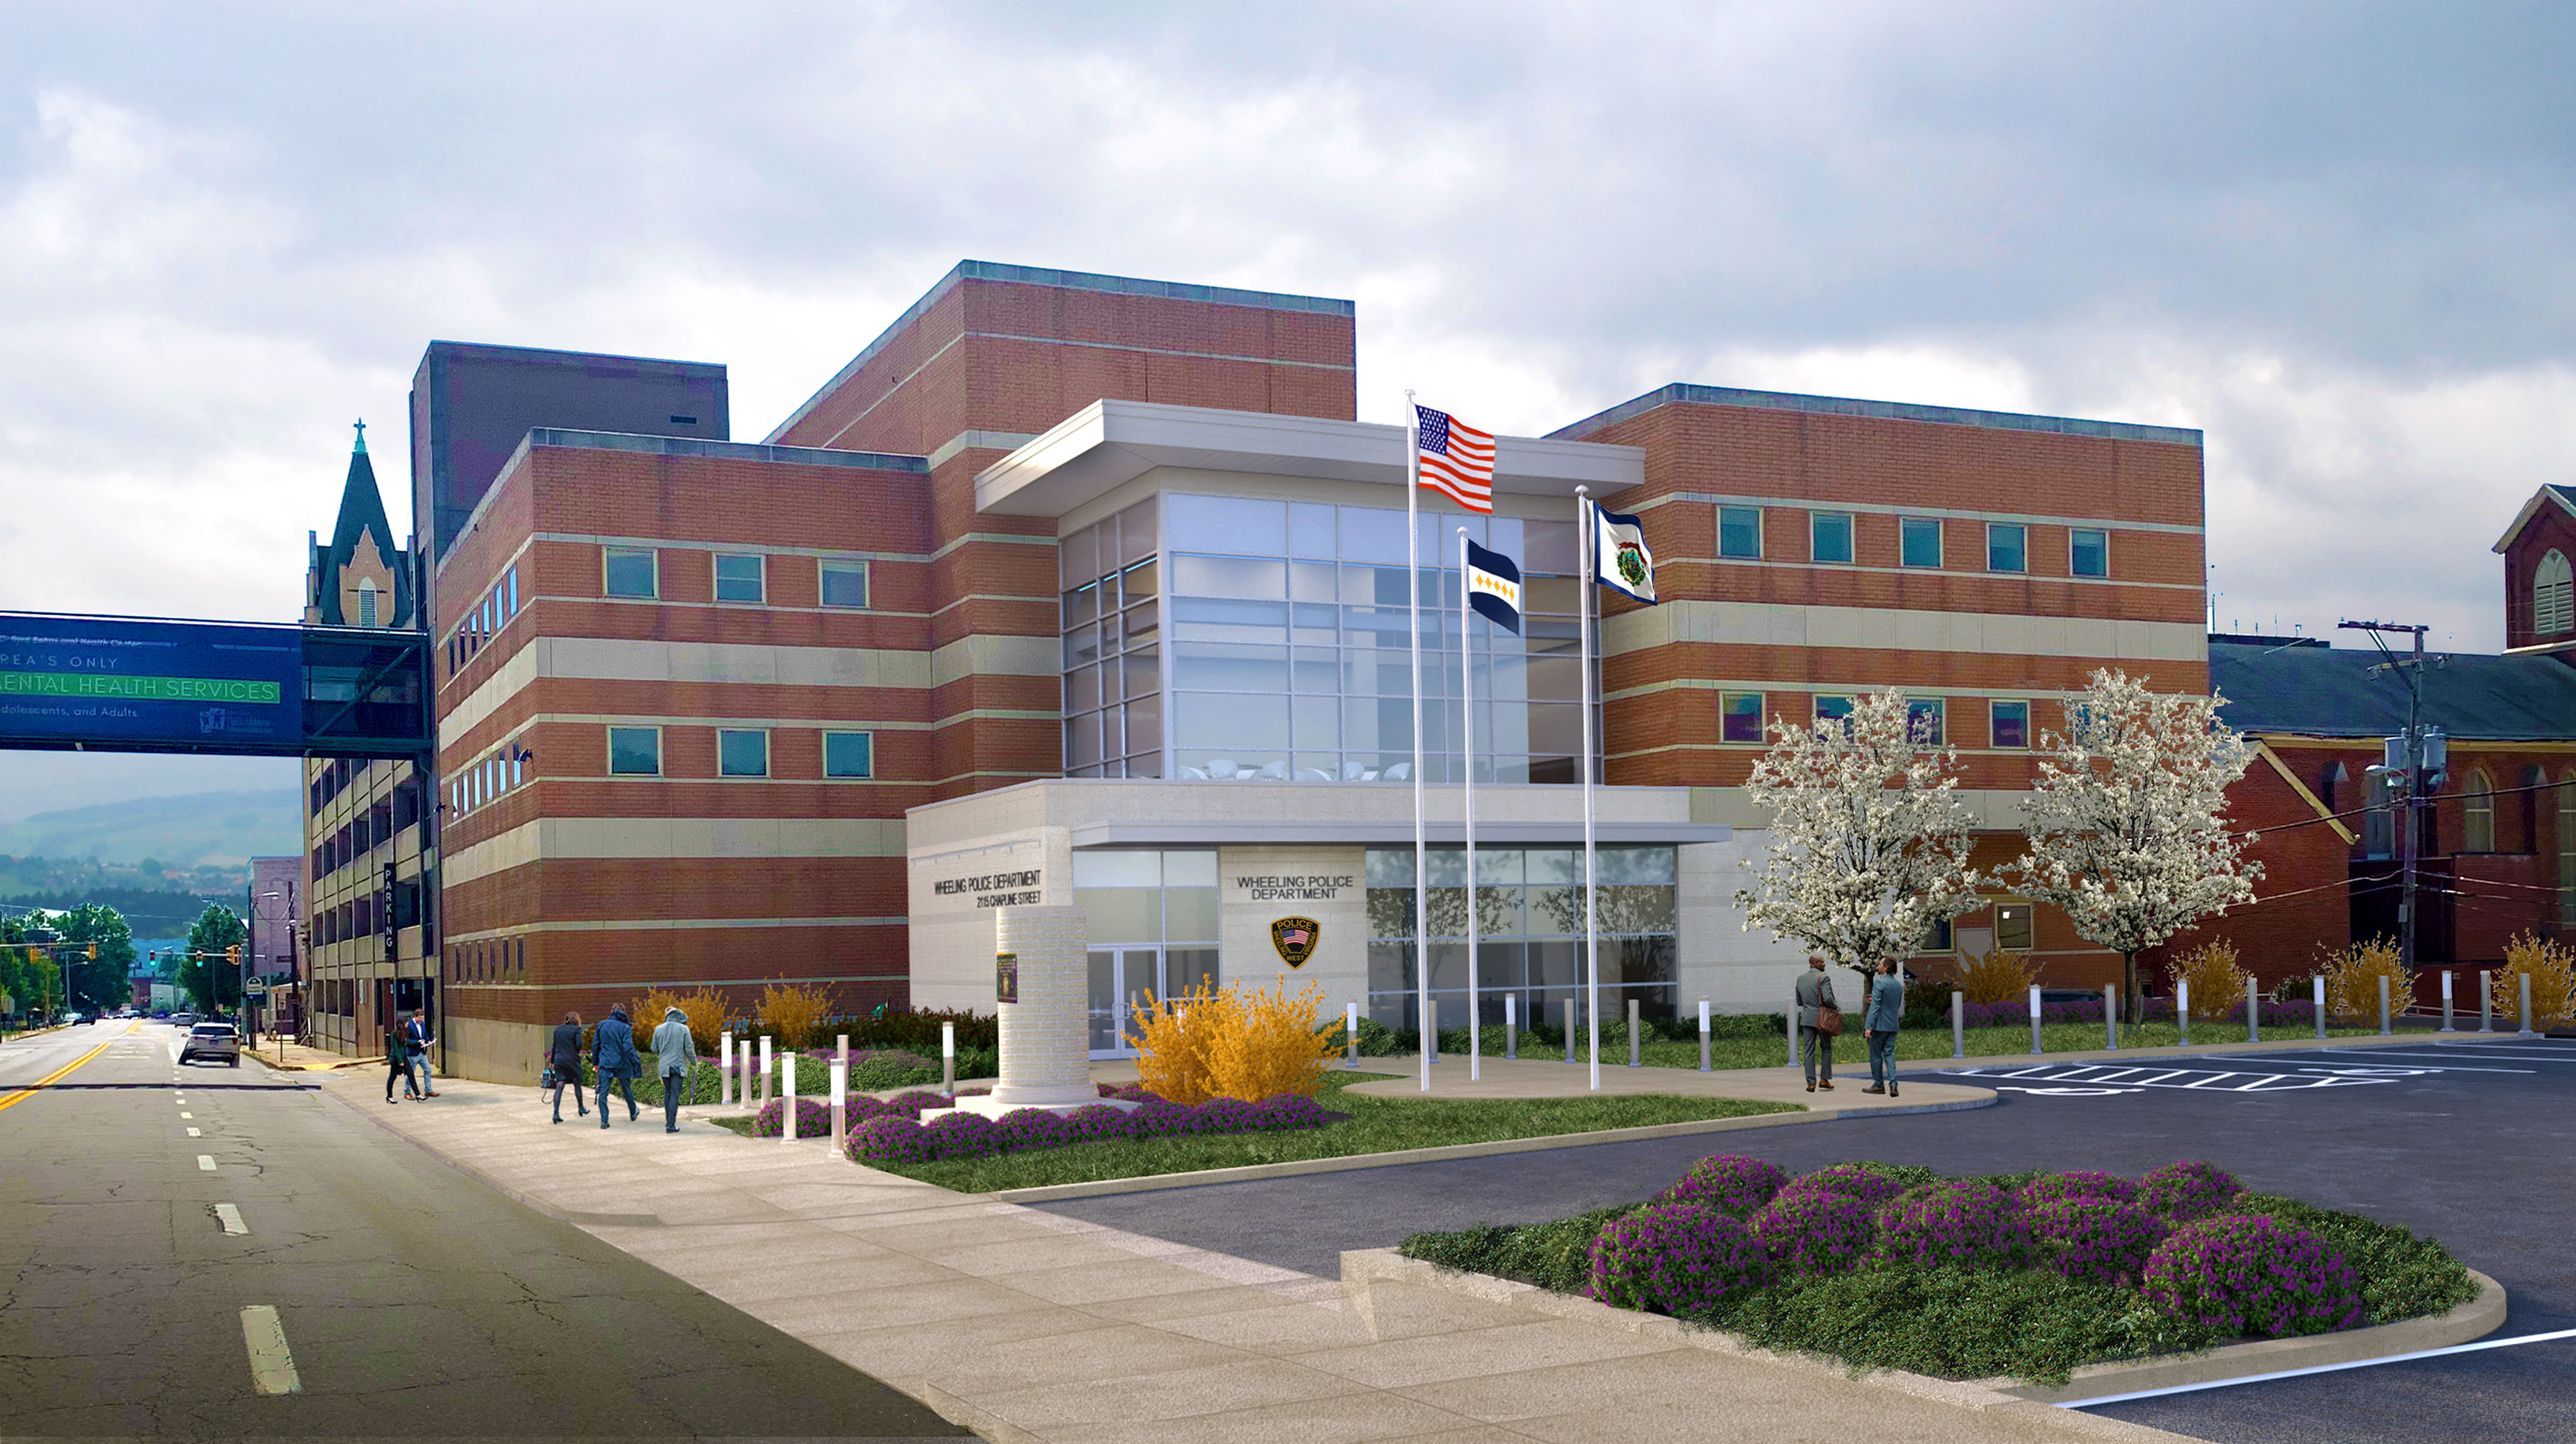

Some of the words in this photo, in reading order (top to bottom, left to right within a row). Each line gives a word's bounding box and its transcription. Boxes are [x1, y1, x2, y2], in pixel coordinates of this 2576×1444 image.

[0, 654, 58, 667] REA'S
[70, 656, 118, 668] ONLY
[0, 674, 70, 693] ENTAL
[79, 677, 157, 696] HEALTH
[166, 680, 275, 700] SERVICES
[0, 704, 70, 716] dolescents,
[74, 707, 96, 716] and
[100, 707, 138, 718] Adults
[934, 879, 967, 895] WHEELING
[968, 875, 992, 892] POLICE
[993, 870, 1041, 889] DEPARTMENT
[1238, 877, 1305, 888] WHEELING
[1309, 876, 1353, 888] POLICE
[976, 896, 989, 908] 2115
[989, 893, 1017, 907] CHAPLINE
[1017, 891, 1041, 905] STREET
[1252, 888, 1337, 900] DEPARTMENT
[385, 869, 393, 947] PARKING
[1277, 919, 1313, 930] POLICE
[1302, 932, 1316, 955] VIRGINIA
